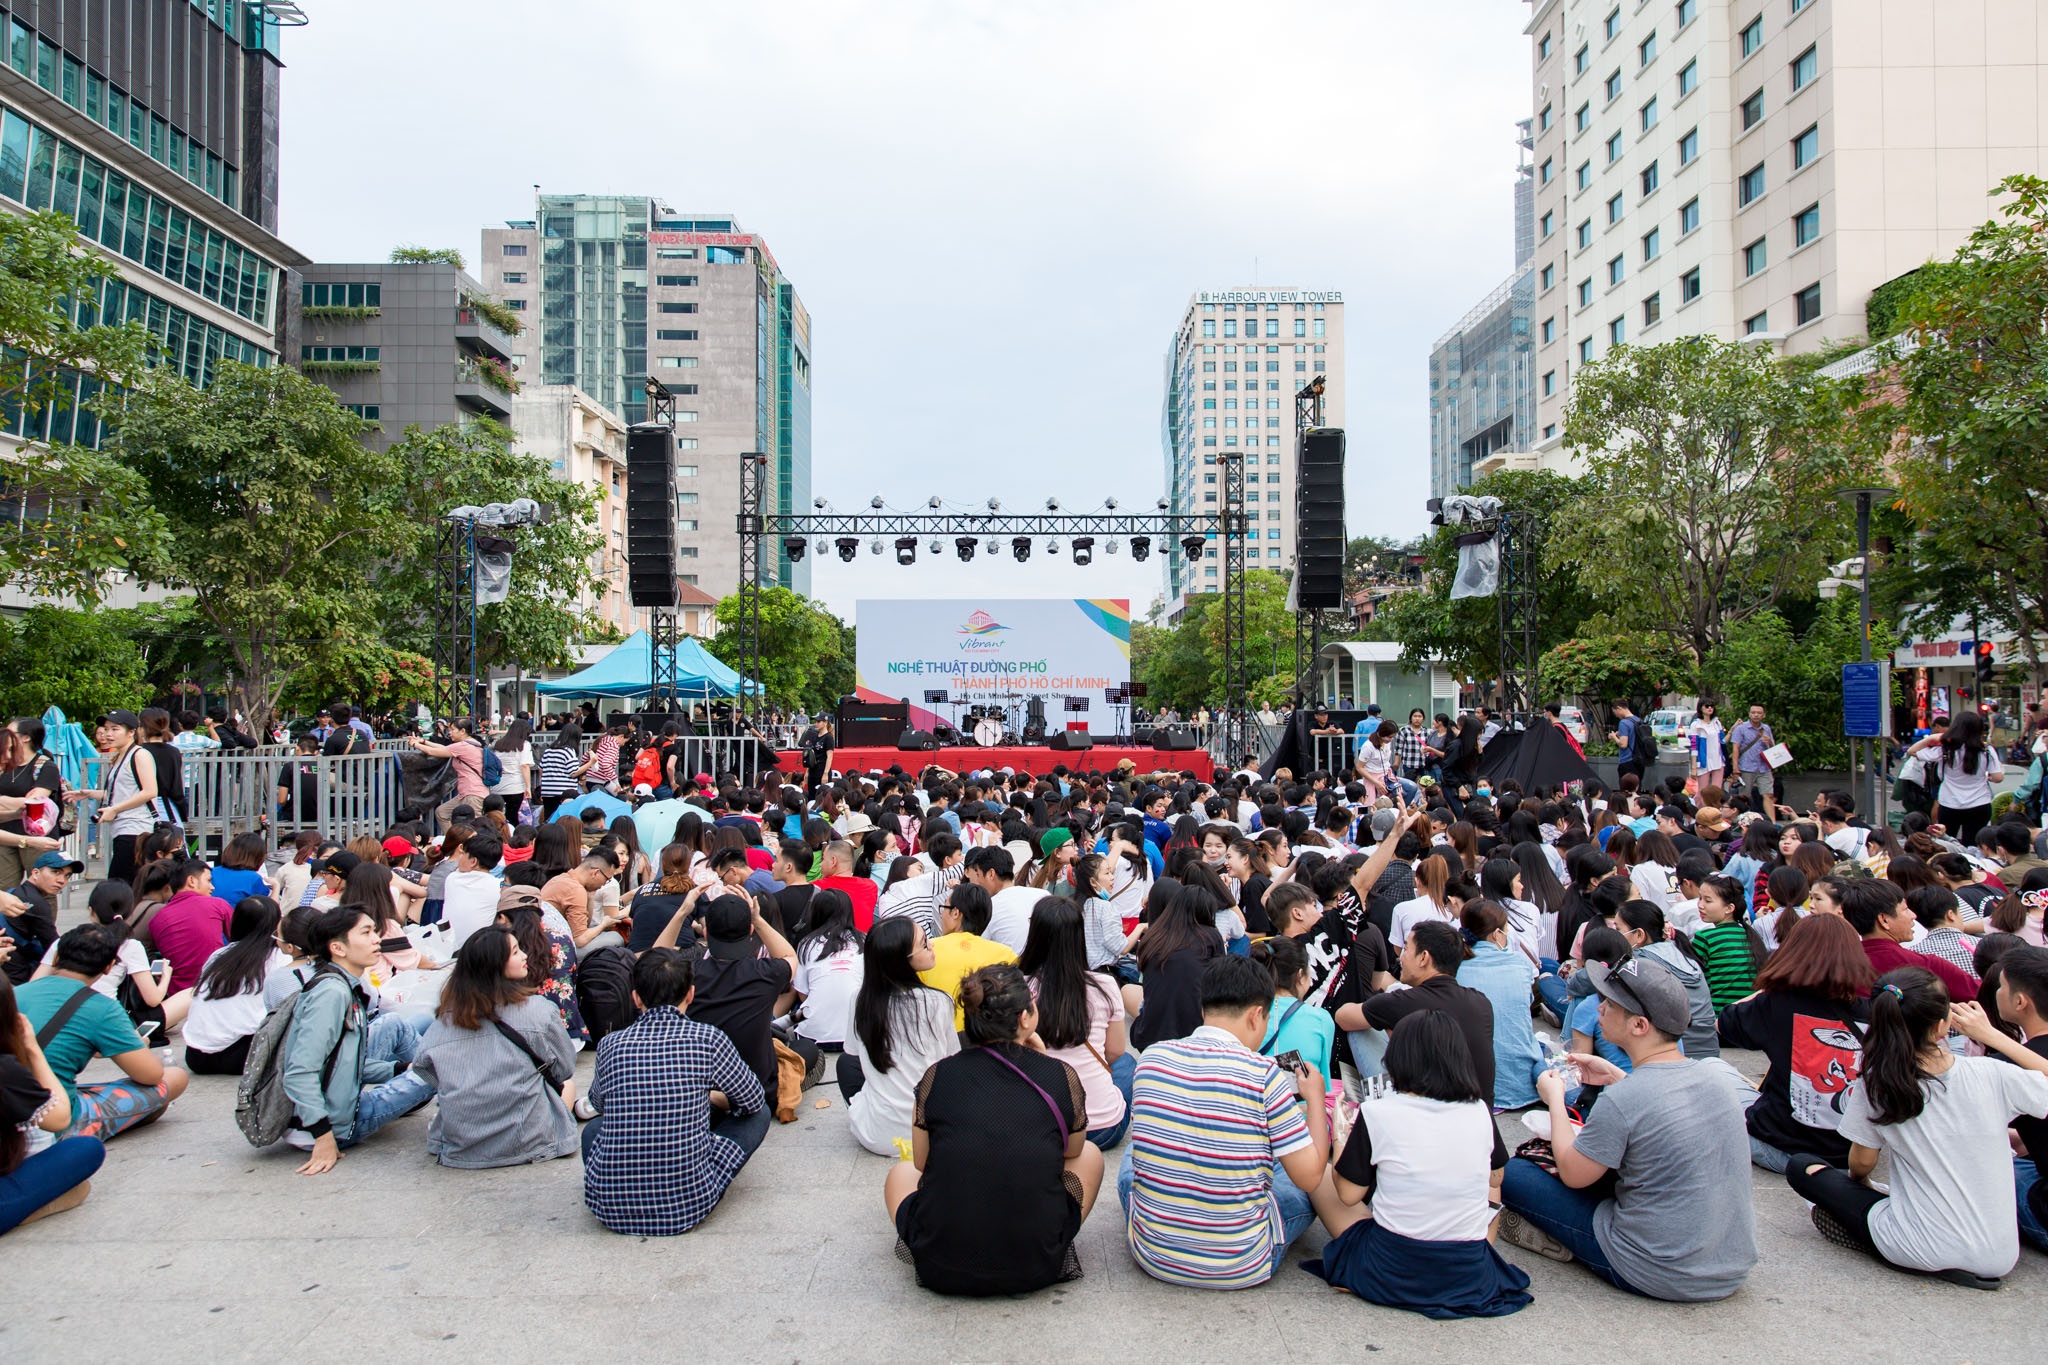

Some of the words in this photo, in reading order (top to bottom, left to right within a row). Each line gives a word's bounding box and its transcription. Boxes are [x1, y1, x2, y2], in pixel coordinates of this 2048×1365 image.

[728, 234, 753, 245] TOWER
[1212, 292, 1266, 302] HARBOUR
[1270, 292, 1298, 302] VIEW
[1301, 291, 1342, 301] TOWER
[960, 638, 1006, 650] Vibrant
[888, 659, 924, 676] NGHỆ
[925, 659, 969, 676] THUẬT
[970, 659, 1017, 673] ĐƯỜNG
[1019, 658, 1048, 673] PHỐ
[951, 675, 997, 689] THÀNH
[1000, 674, 1027, 689] PHỐ
[1029, 674, 1049, 689] HỒ
[1051, 674, 1074, 689] CHÍ
[1075, 677, 1110, 689] MINH
